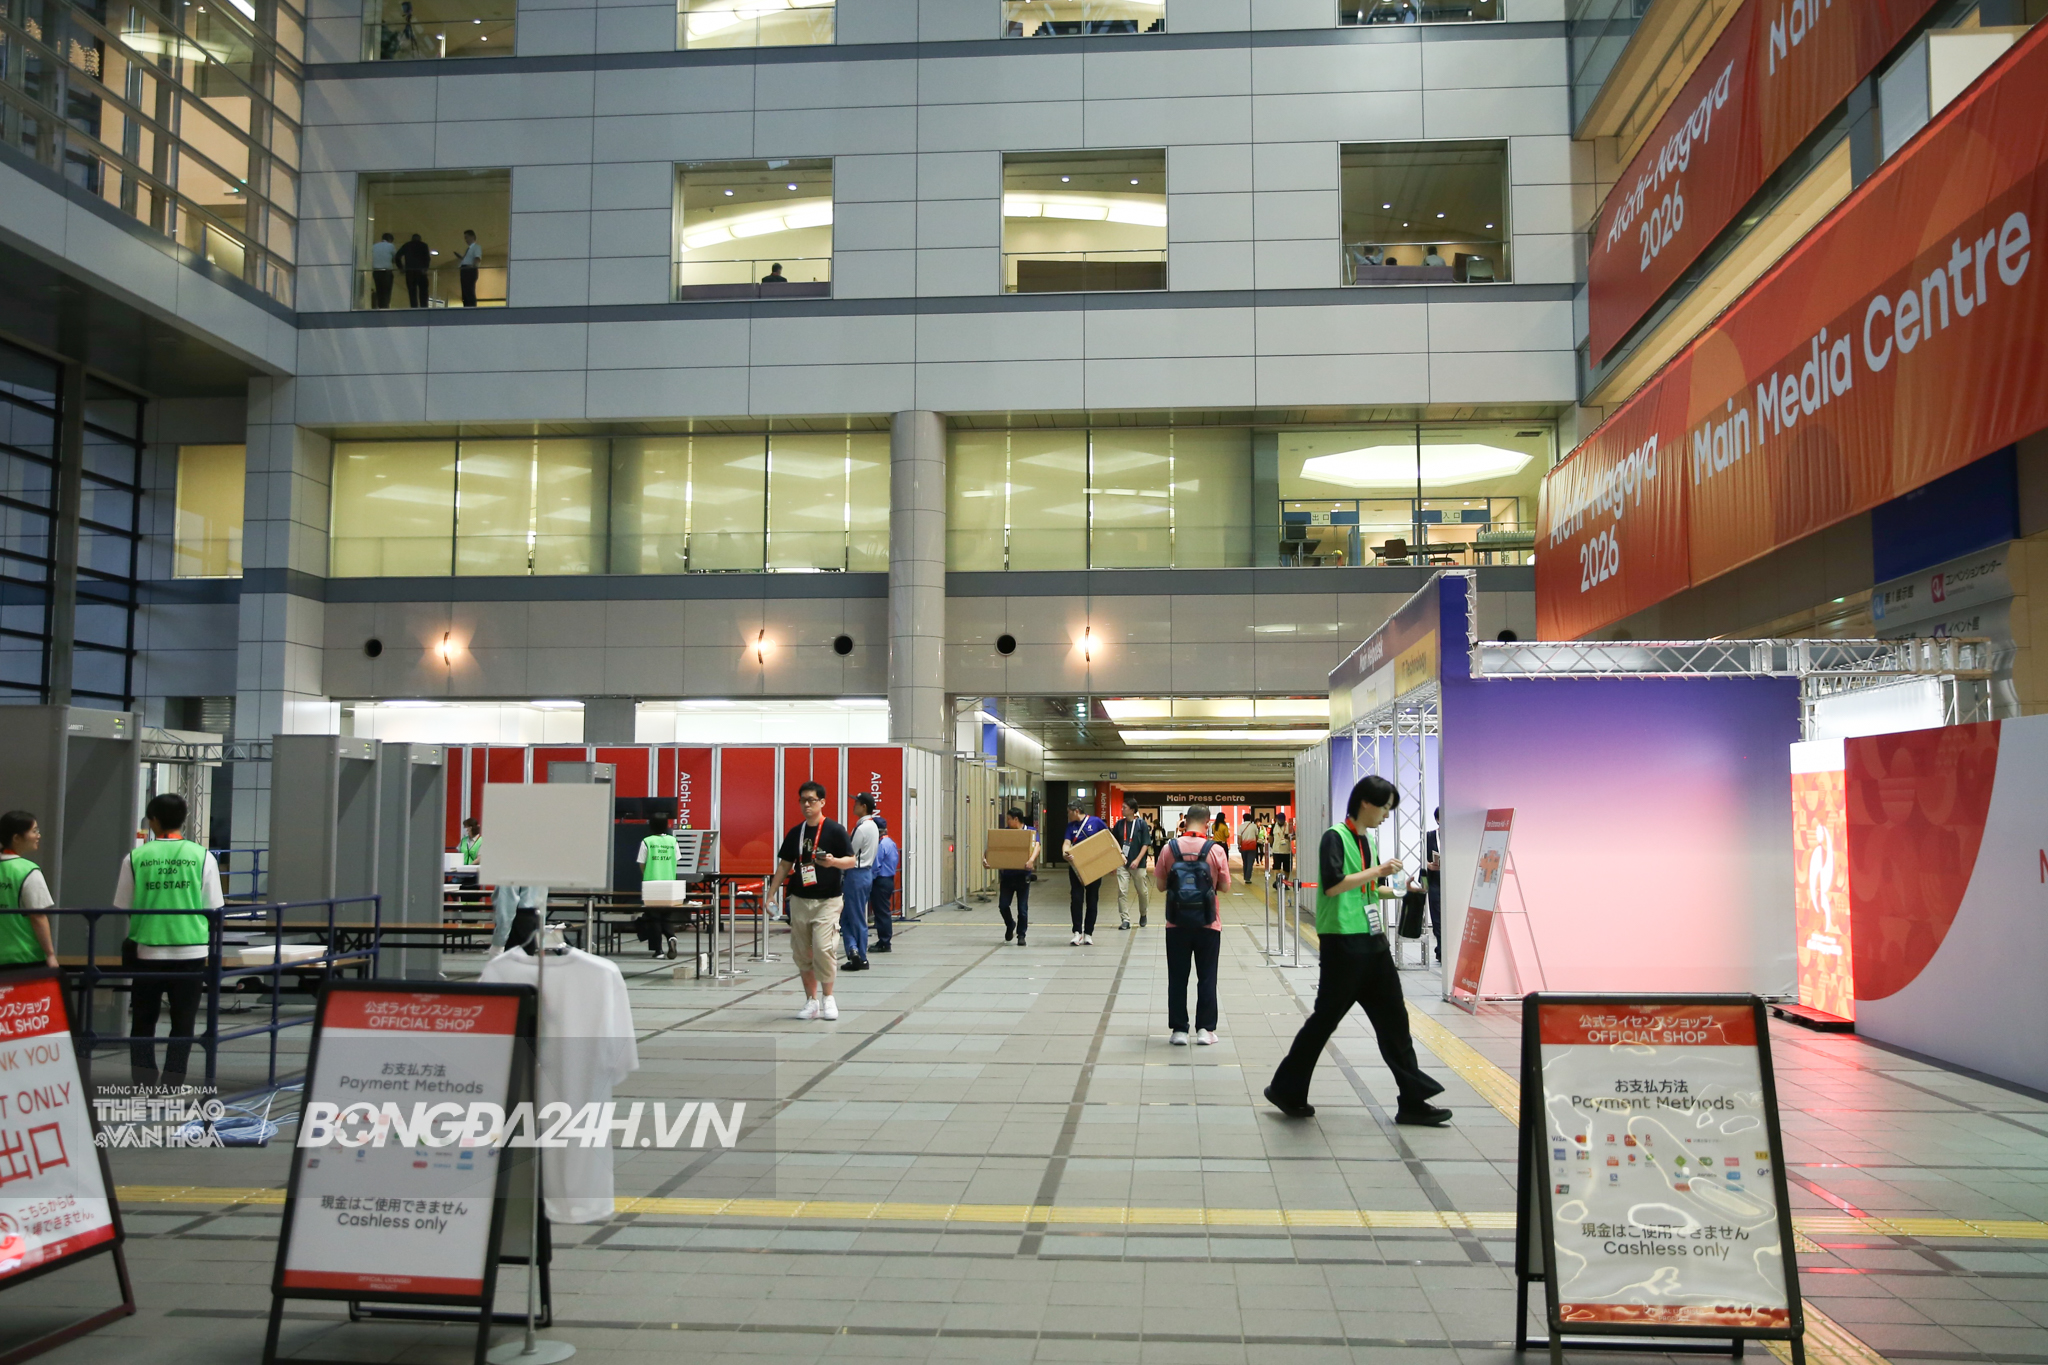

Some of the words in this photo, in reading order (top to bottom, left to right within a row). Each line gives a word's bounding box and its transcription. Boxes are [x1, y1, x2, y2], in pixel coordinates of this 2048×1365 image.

[1607, 59, 1734, 253] Aichi-Nagoya
[1640, 179, 1684, 272] 2026
[1694, 397, 1750, 486] Main
[1757, 327, 1852, 446] Media
[1863, 211, 2031, 373] Centre
[1550, 433, 1658, 549] Aichi-Nagoya
[1580, 524, 1619, 593] 2026
[1166, 793, 1187, 802] Main
[1188, 793, 1213, 802] Press
[1214, 793, 1246, 802] Centre
[140, 858, 197, 868] Aichi-Nagoya
[157, 867, 178, 875] 2026
[163, 881, 191, 890] STAFF
[364, 1000, 485, 1018] 公式ライセンスショップ
[15, 1015, 50, 1033] SHOP
[369, 1015, 431, 1030] OFFICIAL
[435, 1017, 475, 1031] SHOP
[1579, 1014, 1714, 1031] 公式ライセンスショップ
[1587, 1030, 1659, 1043] OFFICIAL
[1662, 1030, 1708, 1043] SHOP
[24, 1042, 61, 1067] YOU
[381, 1061, 447, 1078] お支払方法
[340, 1075, 410, 1093] Payment
[414, 1078, 484, 1094] Methods
[1614, 1079, 1690, 1094] お支払方法
[17, 1081, 71, 1115] ONLY
[1571, 1094, 1651, 1111] Payment
[1656, 1095, 1735, 1111] Methods
[0, 1121, 70, 1188] 出口
[19, 1194, 76, 1221] こちらからは
[321, 1194, 468, 1216] 現金はご使用できません
[337, 1212, 410, 1229] Cashless
[414, 1216, 448, 1235] only
[1603, 1240, 1688, 1256] Cashless
[1692, 1242, 1730, 1261] only
